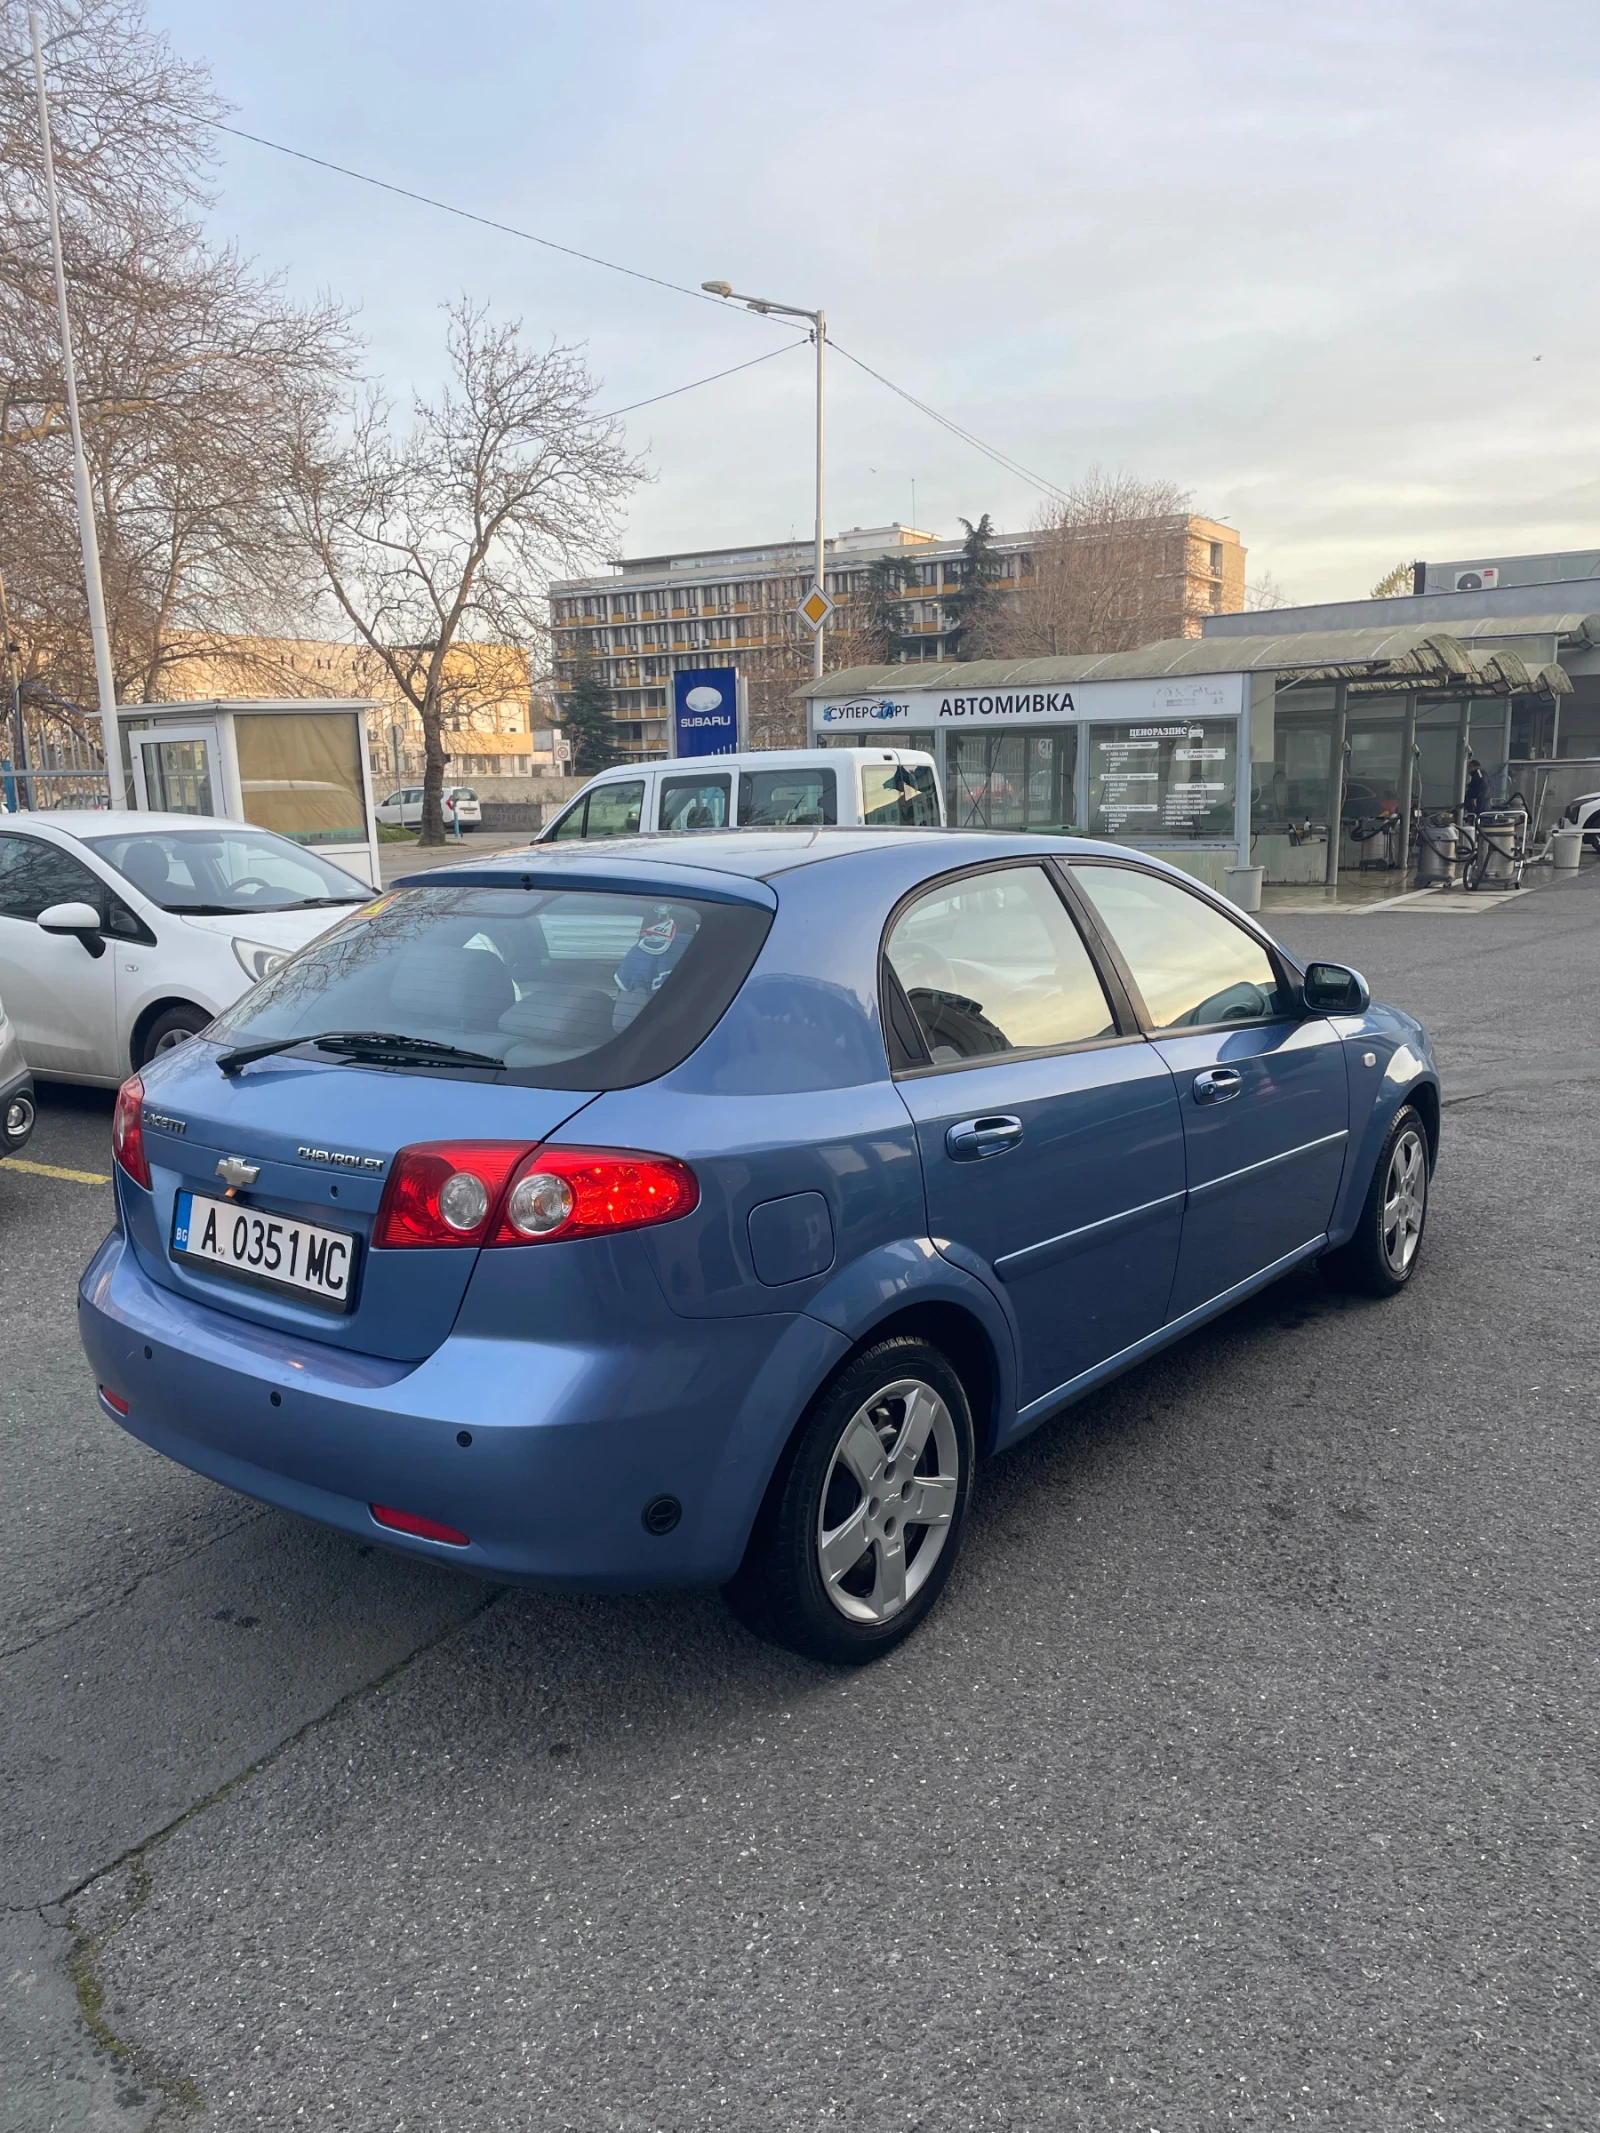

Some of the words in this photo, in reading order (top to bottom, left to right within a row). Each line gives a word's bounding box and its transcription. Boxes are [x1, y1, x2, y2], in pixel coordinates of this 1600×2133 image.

[829, 705, 910, 720] СУПЕРСТАРТ
[939, 692, 1075, 717] АВТОМИВКА
[680, 715, 731, 728] SUBARU
[1129, 726, 1188, 738] ЦЕНОРАЗПИС
[142, 1110, 187, 1134] LACETTI
[297, 1146, 385, 1172] CHEVROLET
[175, 1227, 187, 1243] BG
